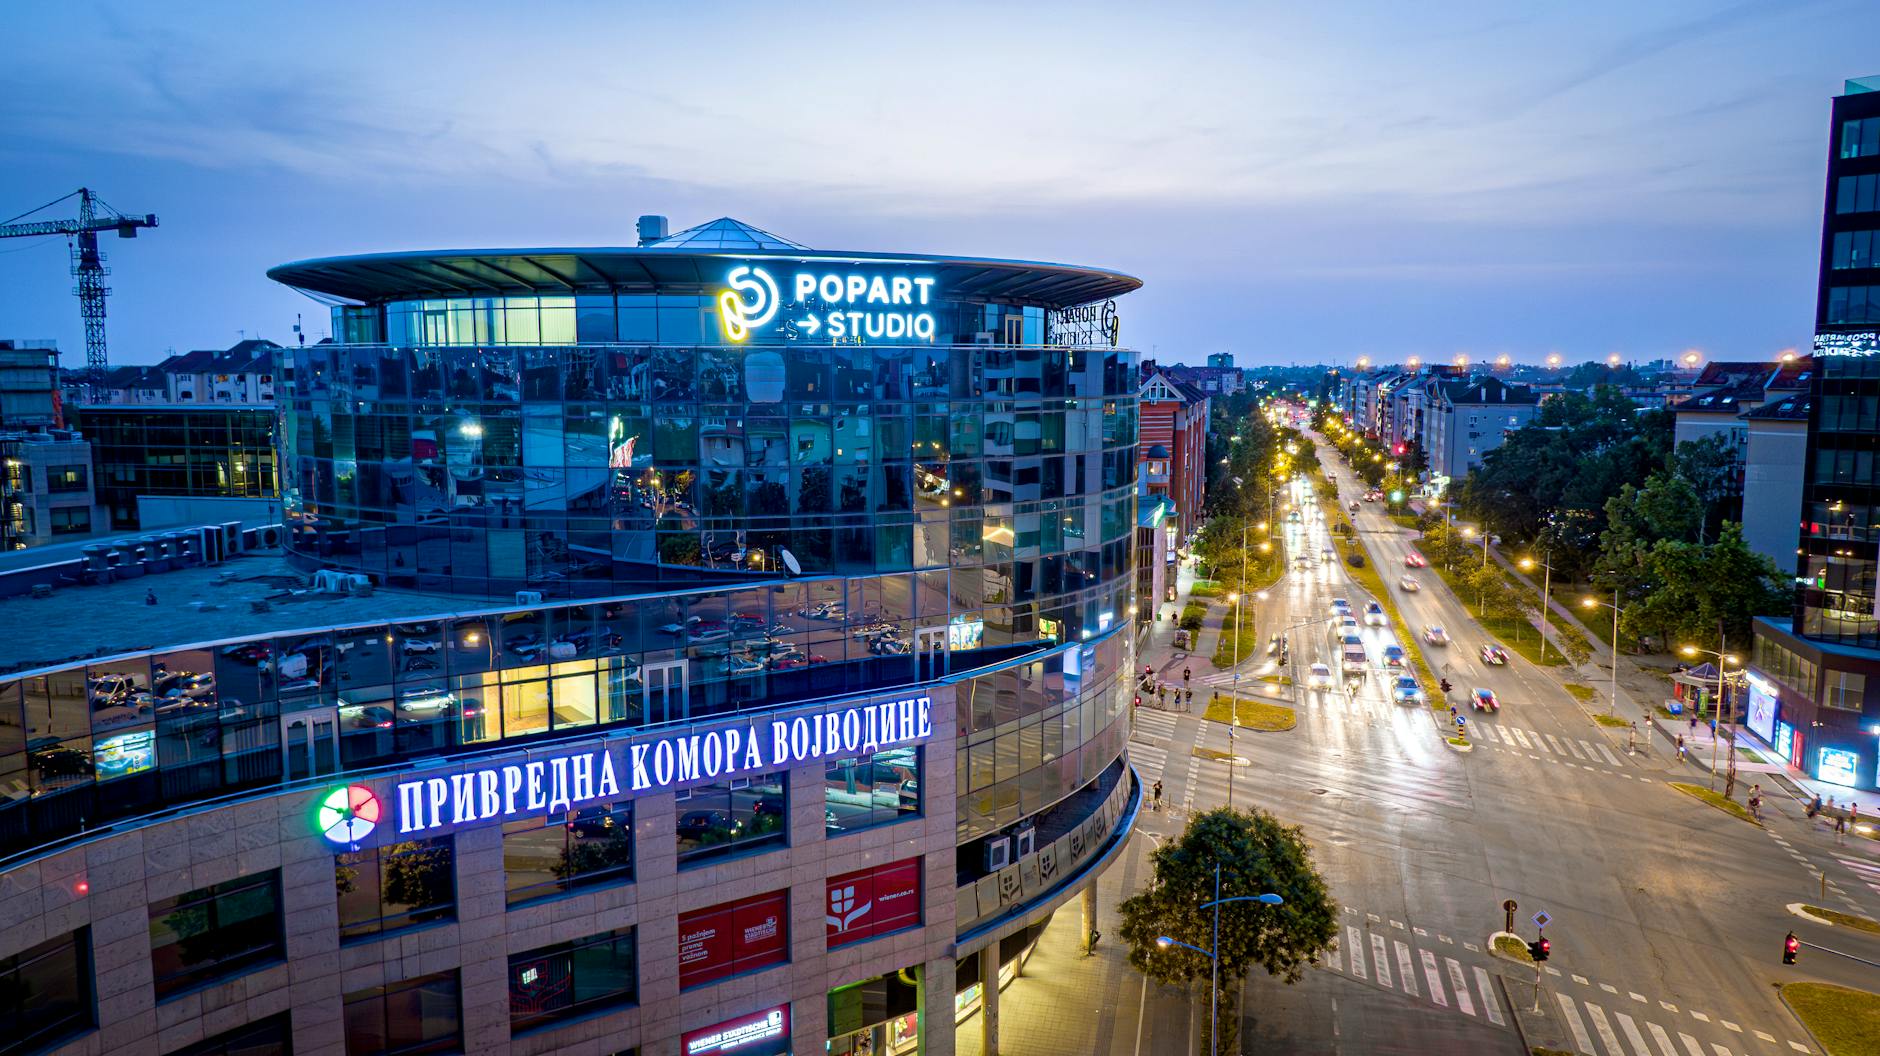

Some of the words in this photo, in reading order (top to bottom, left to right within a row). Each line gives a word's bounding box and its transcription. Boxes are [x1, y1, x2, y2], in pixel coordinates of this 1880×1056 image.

[796, 273, 935, 304] POPART
[827, 312, 935, 338] STUDIO
[397, 749, 620, 834] ПРИВРЕДНА
[630, 725, 763, 791] КОМОРА
[772, 696, 932, 765] ВОЈВОДИНЕ
[689, 1034, 721, 1049] WIENER
